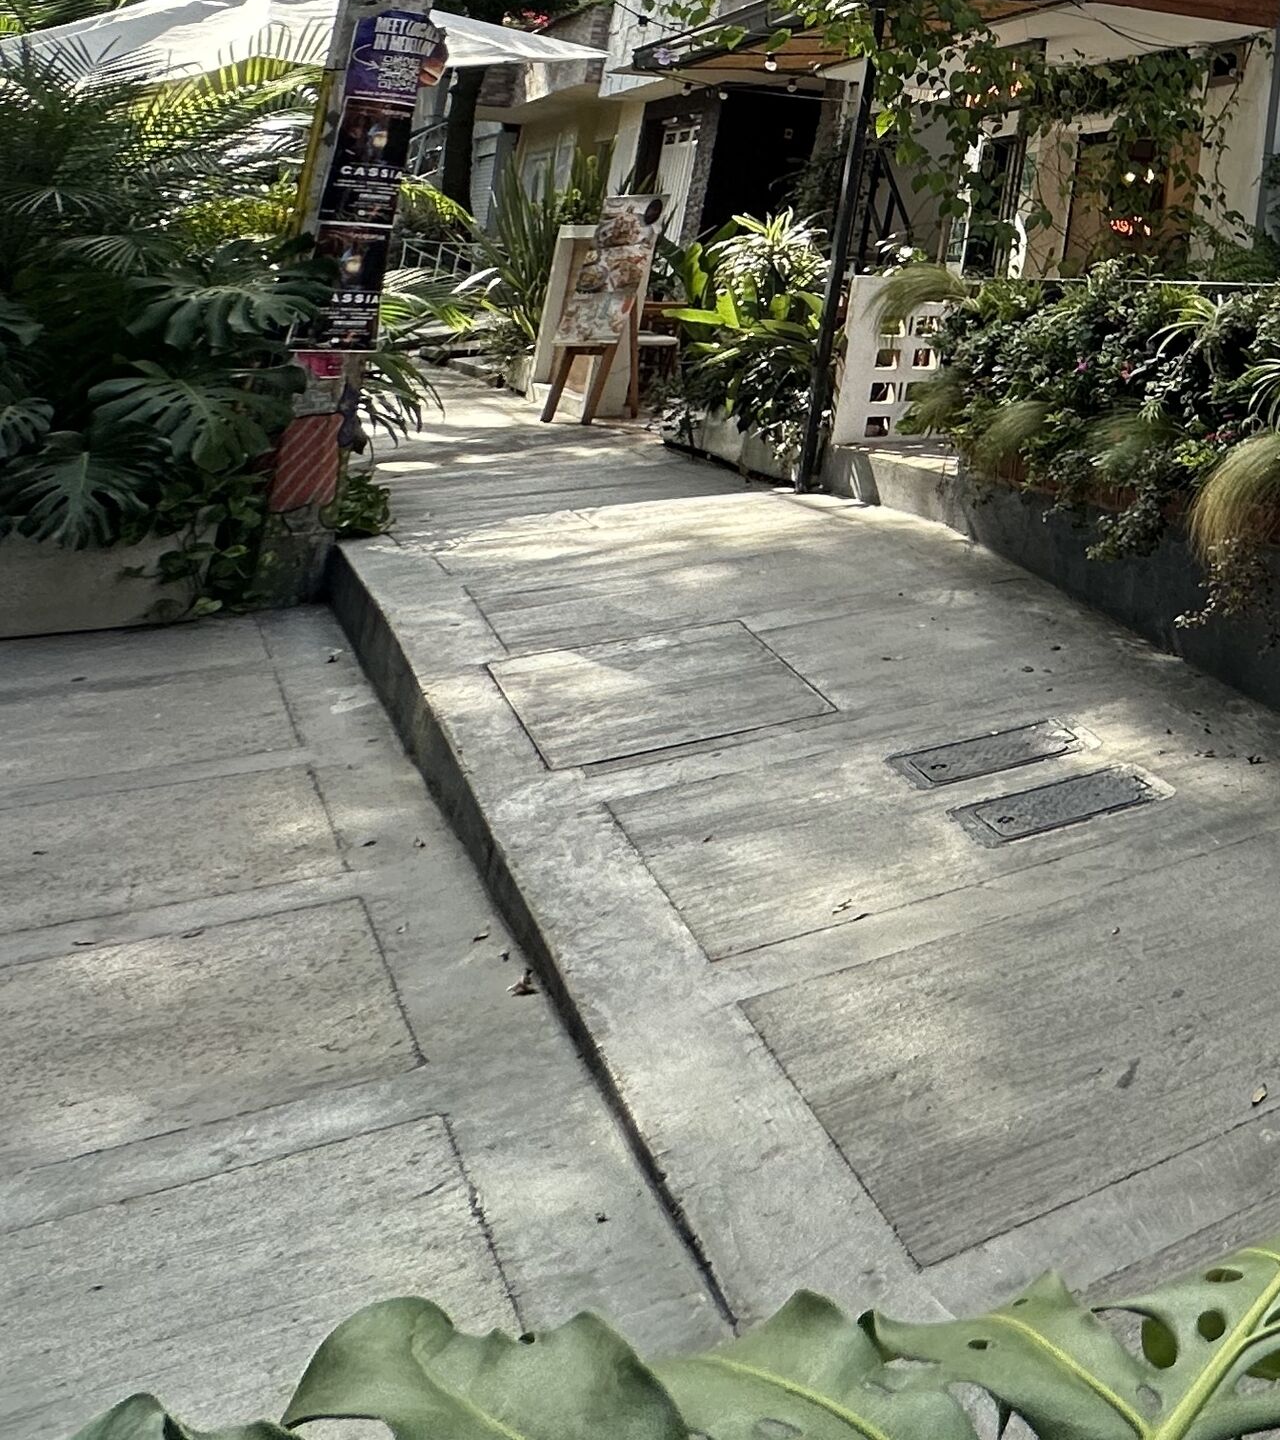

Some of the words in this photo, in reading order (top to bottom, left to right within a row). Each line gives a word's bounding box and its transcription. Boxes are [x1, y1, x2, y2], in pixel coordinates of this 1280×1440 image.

[374, 16, 408, 35] MEET
[406, 19, 442, 44] LOCAL
[372, 33, 389, 51] IN
[331, 292, 380, 305] ASSIA
